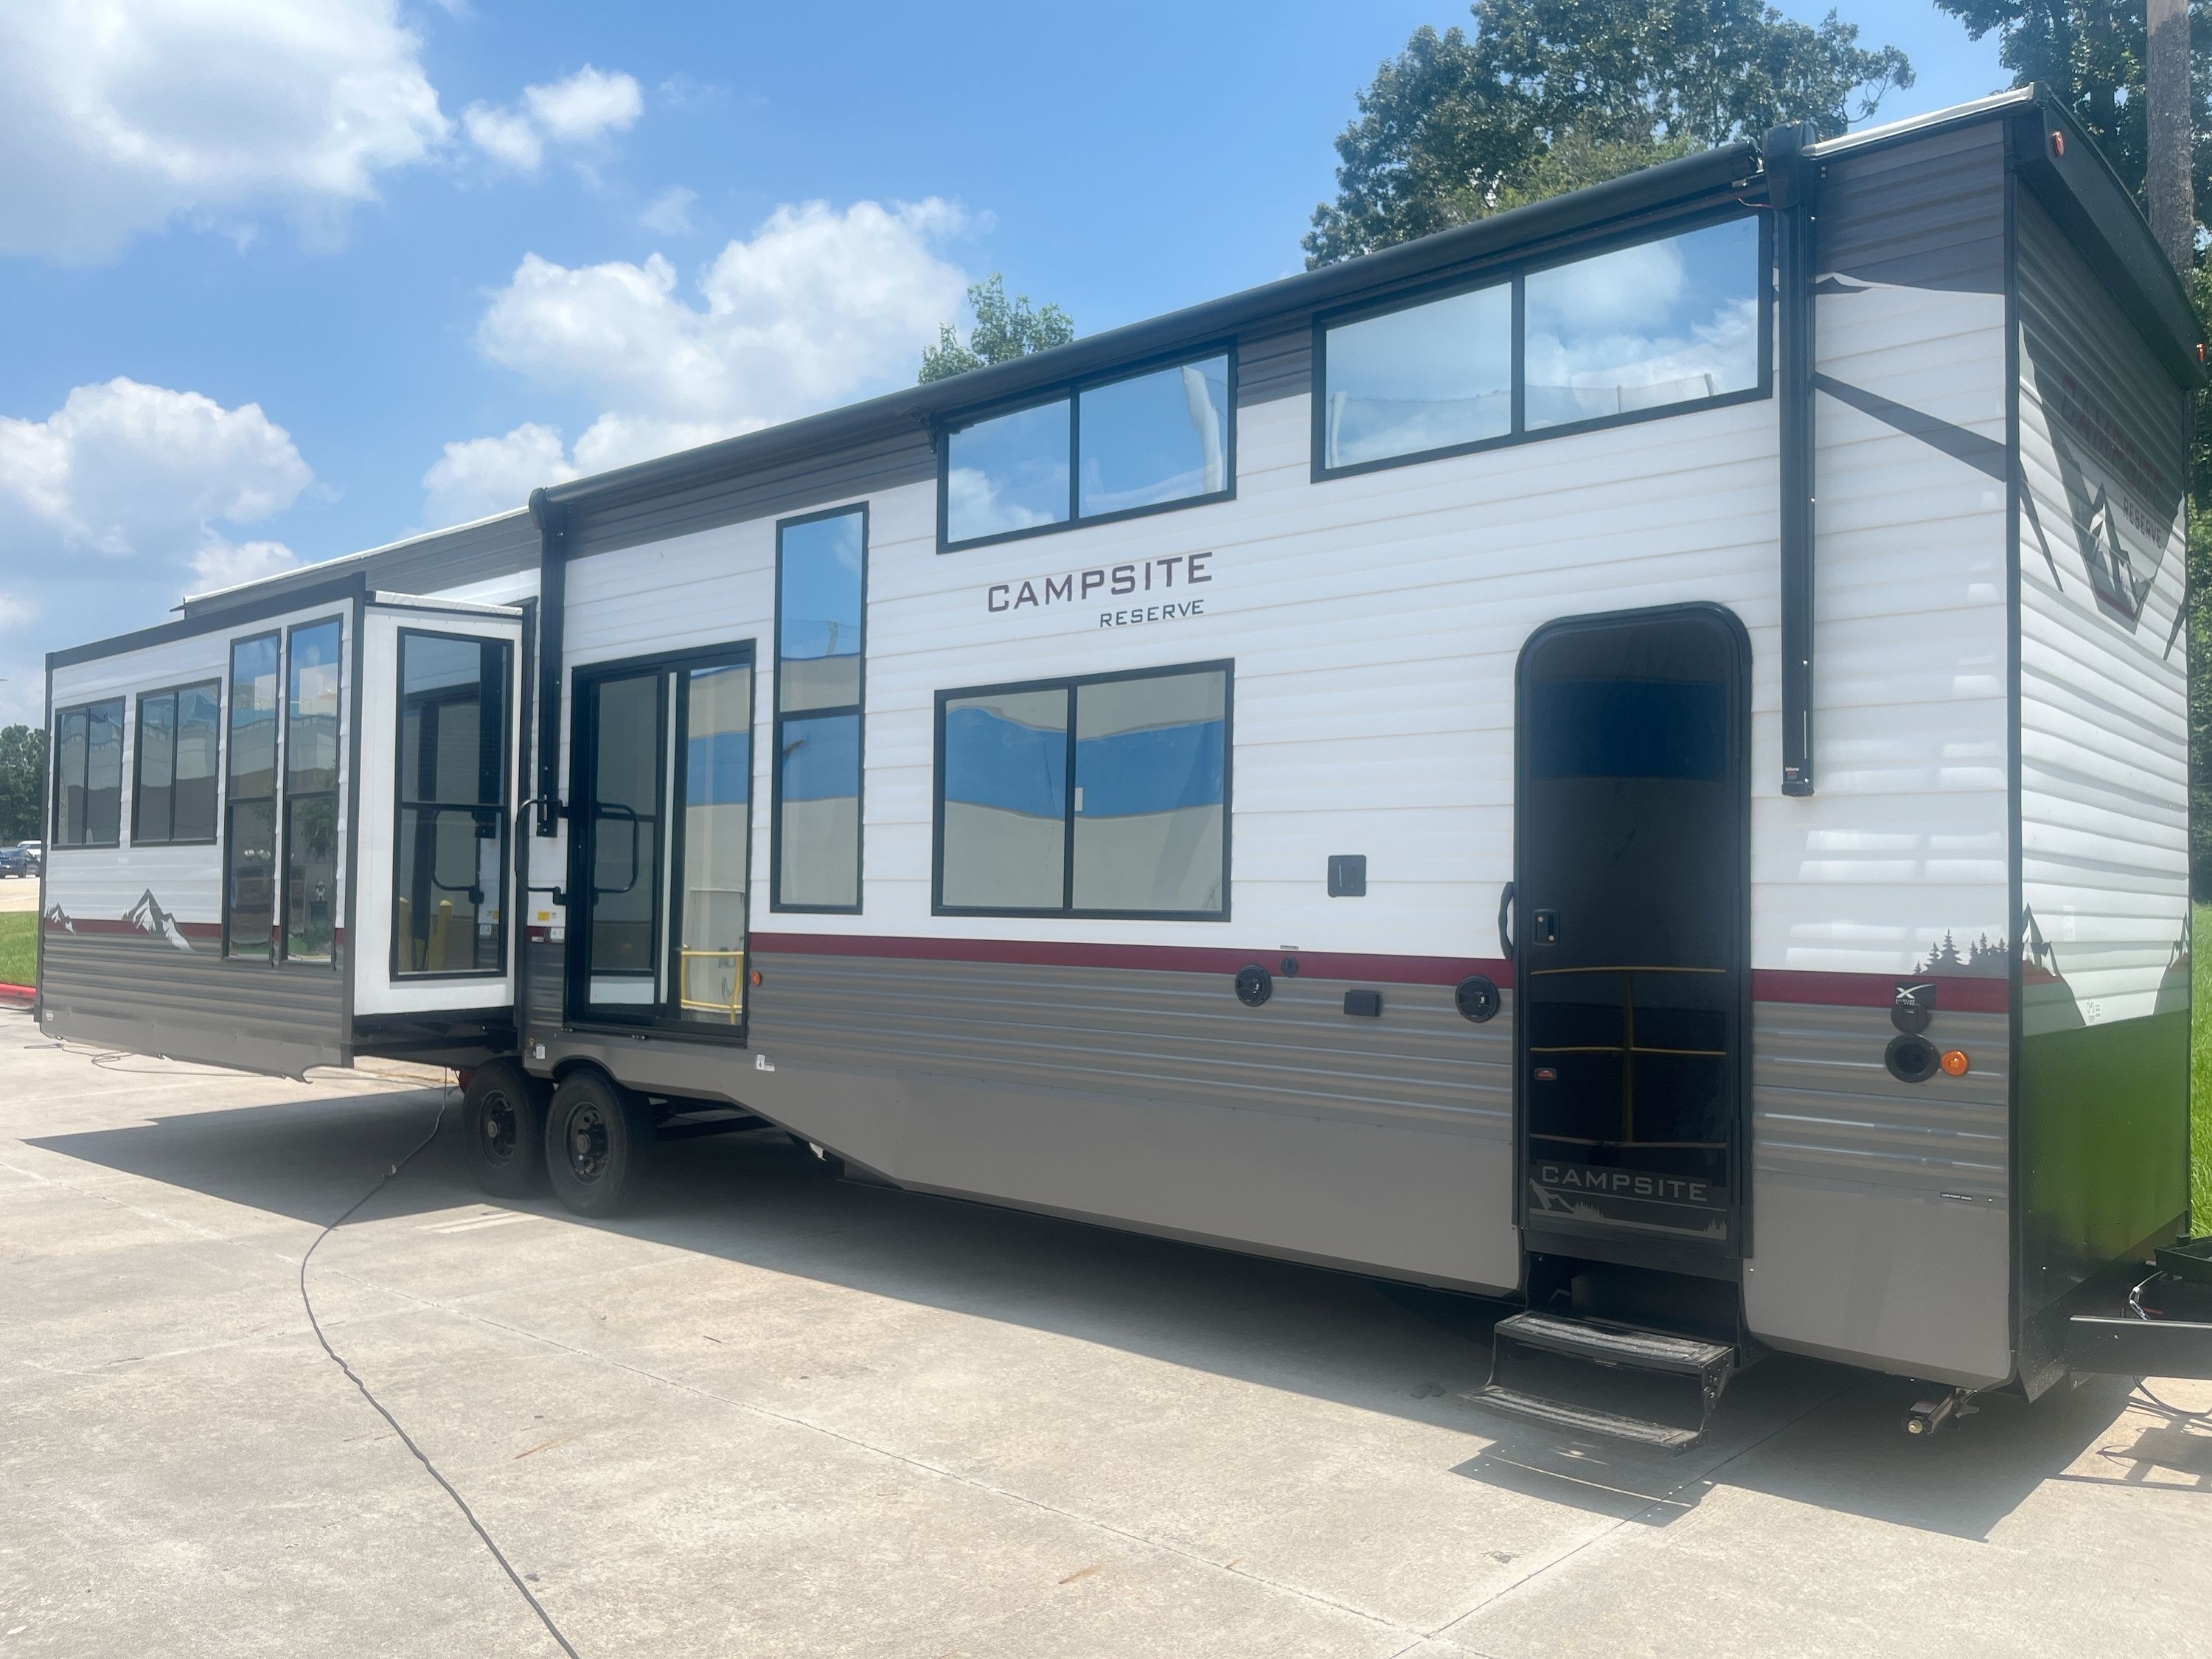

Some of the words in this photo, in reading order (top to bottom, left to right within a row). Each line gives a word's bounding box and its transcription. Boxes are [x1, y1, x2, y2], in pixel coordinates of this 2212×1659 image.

[2123, 495, 2162, 549] RESERVE
[988, 552, 1213, 613] CAMPSITE
[1099, 599, 1204, 628] RESERVE
[1541, 1166, 1707, 1202] CAMPSITE
